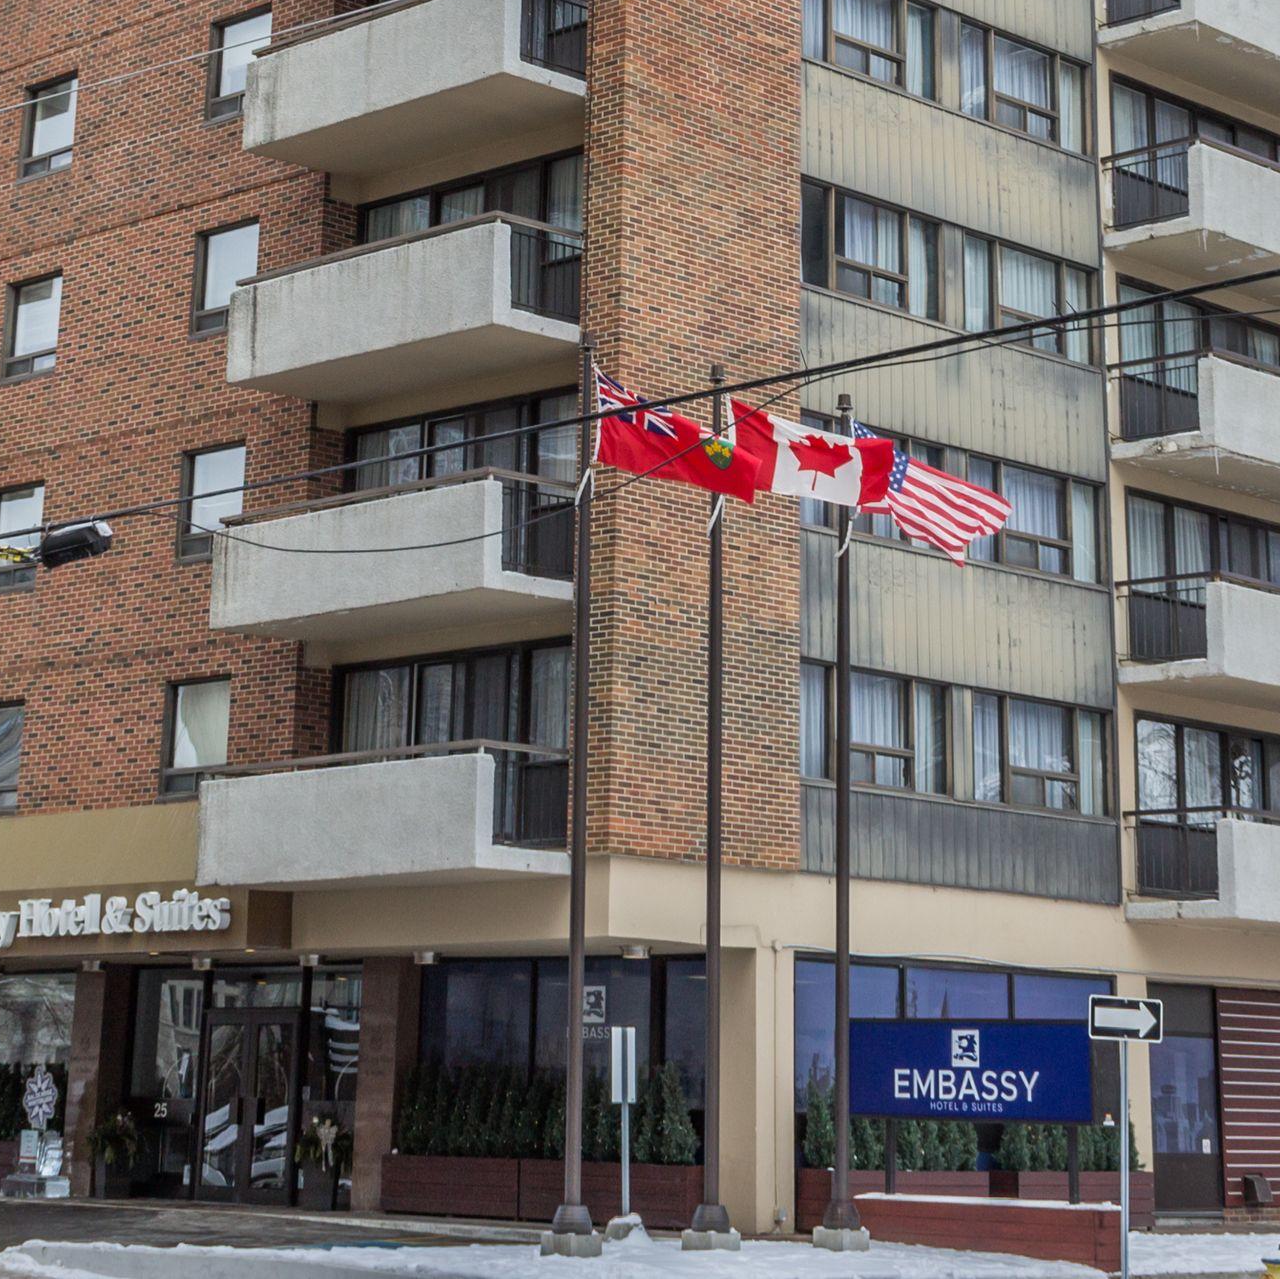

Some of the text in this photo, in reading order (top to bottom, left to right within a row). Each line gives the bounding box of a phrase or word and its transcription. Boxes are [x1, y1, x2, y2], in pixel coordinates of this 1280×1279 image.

[17, 893, 101, 938] Hotel
[101, 895, 134, 934] &
[134, 888, 231, 933] Suites
[567, 1026, 611, 1039] BASS
[894, 1069, 1039, 1102] EMBASSY
[154, 1102, 168, 1118] 25
[930, 1102, 1004, 1112] HOTEL & SUITES
